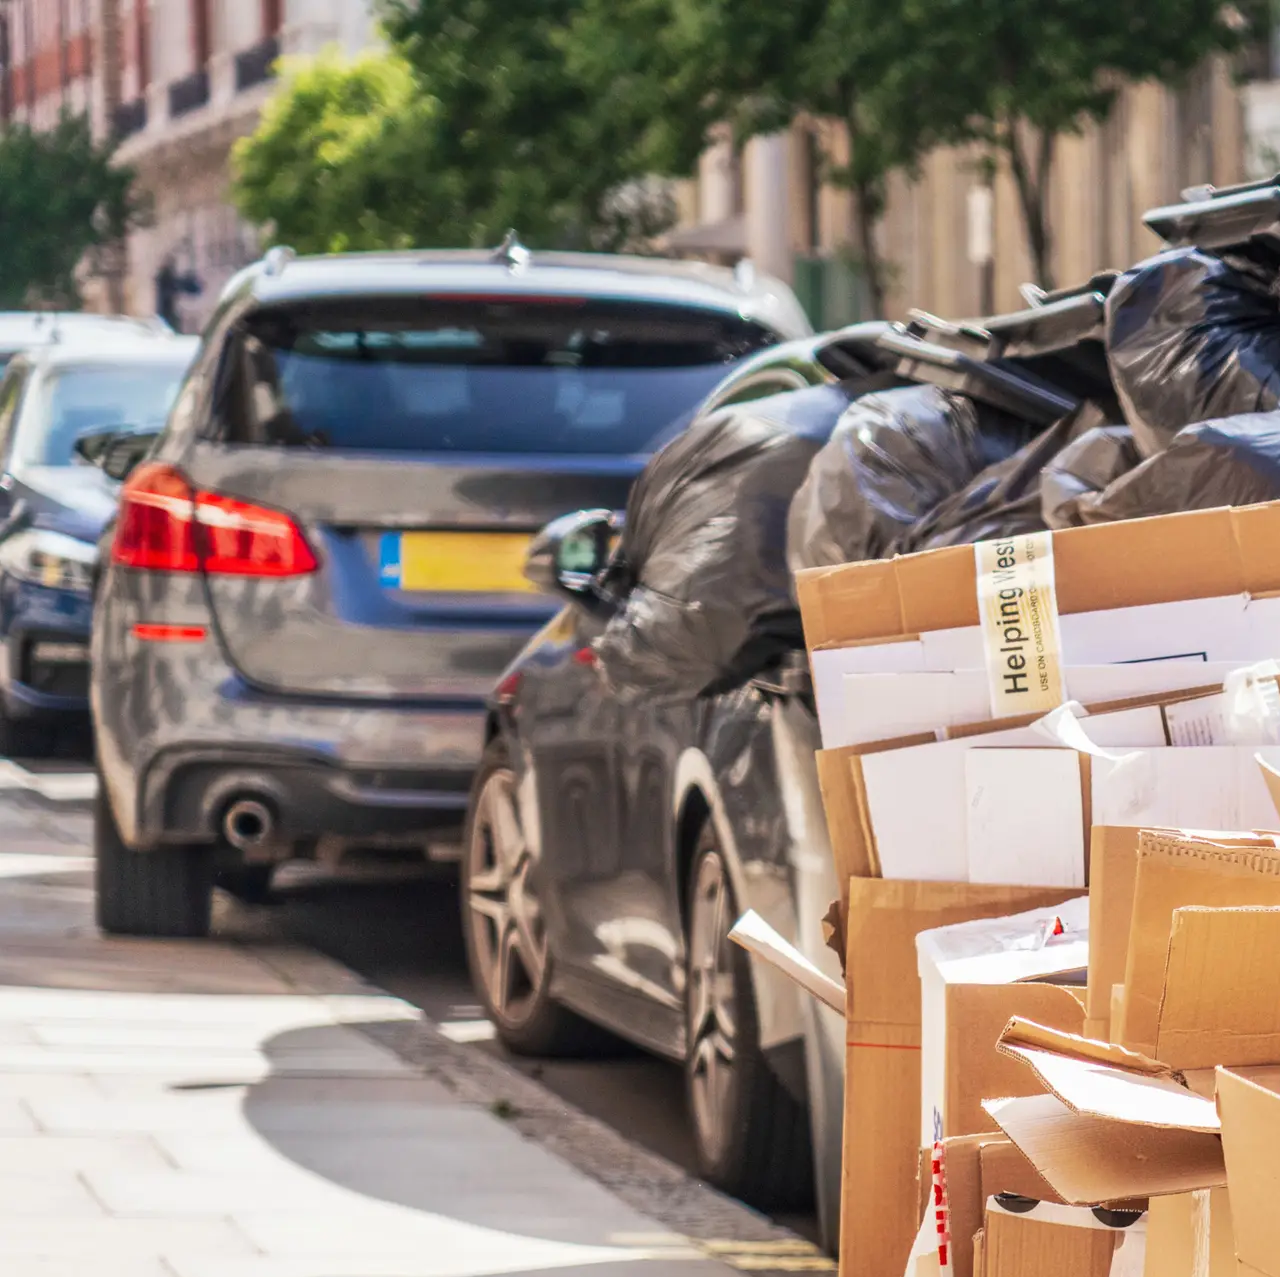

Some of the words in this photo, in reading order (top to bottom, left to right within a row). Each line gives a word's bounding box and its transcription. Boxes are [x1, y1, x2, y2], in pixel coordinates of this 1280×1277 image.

[997, 587, 1030, 694] Helping
[1030, 594, 1045, 653] CARDBOARD
[1037, 655, 1046, 670] ON
[1040, 671, 1049, 692] USE
